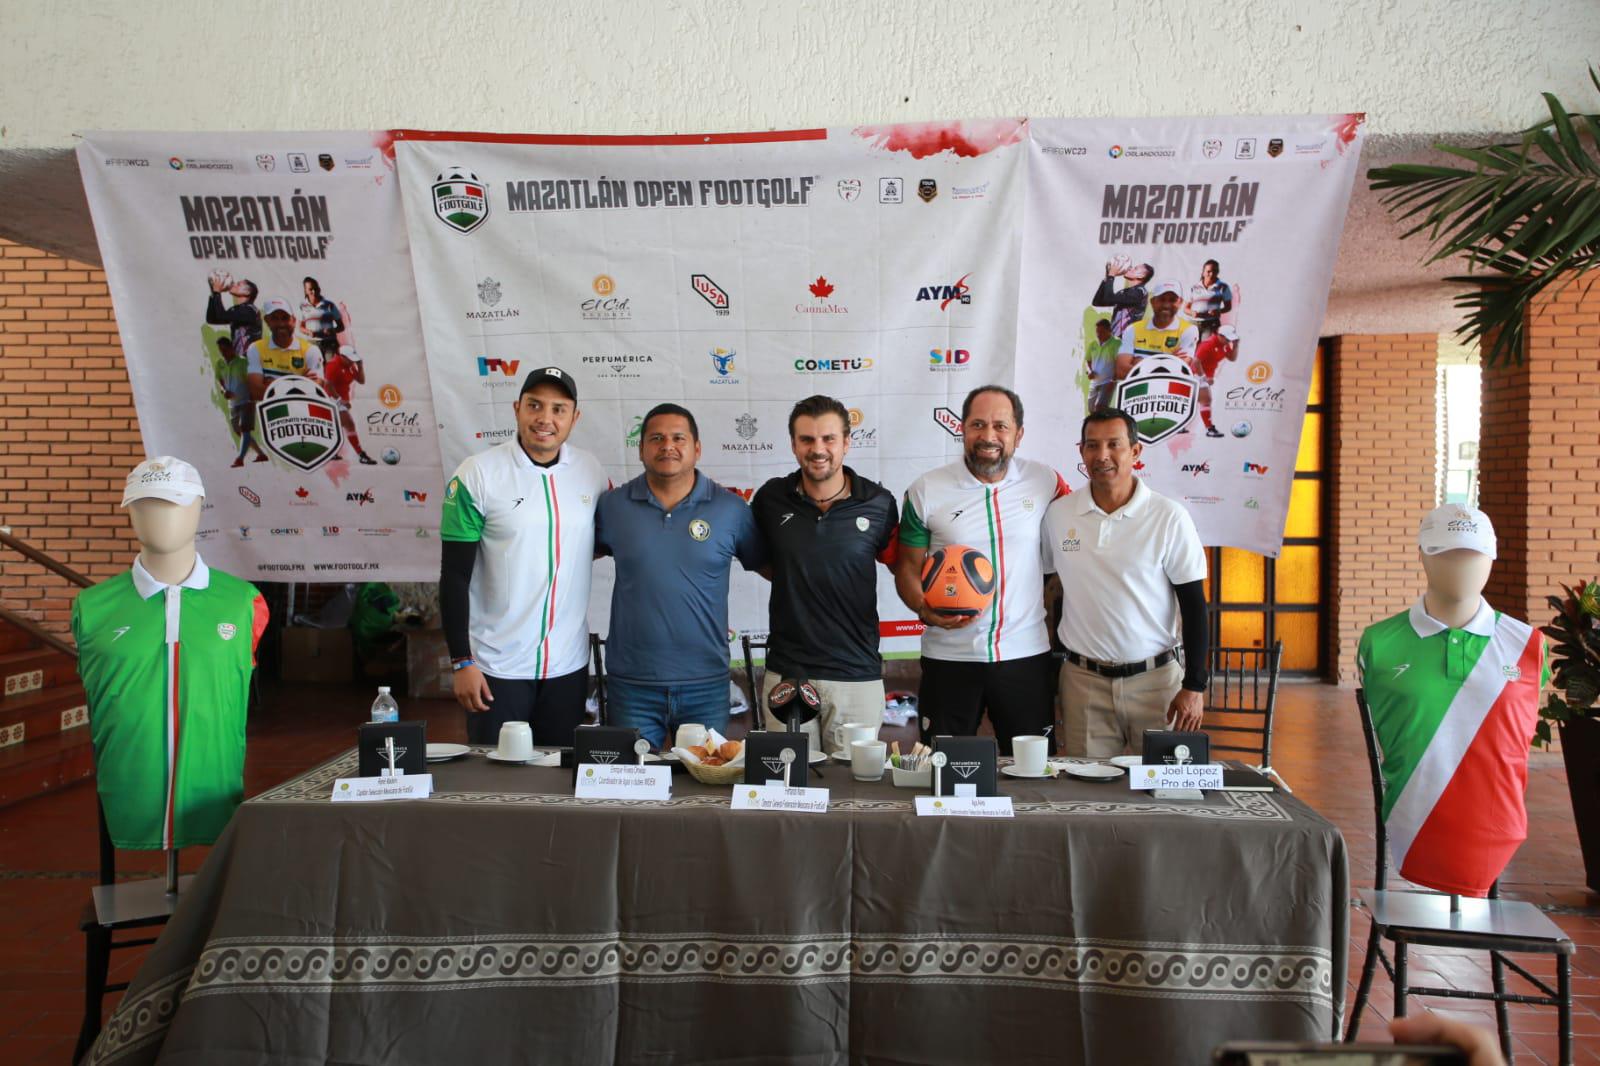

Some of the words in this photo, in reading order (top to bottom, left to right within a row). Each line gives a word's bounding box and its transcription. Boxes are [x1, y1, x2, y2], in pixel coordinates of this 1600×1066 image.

[506, 176, 628, 211] MAZATLÁN
[633, 180, 693, 207] OPEN
[699, 176, 814, 208] FOOTGOLF
[1102, 176, 1259, 219] MAZATLÁN
[180, 188, 331, 232] MAZATLÁN
[439, 199, 484, 212] FOOTGOLF
[1100, 221, 1146, 245] OPEN
[1152, 220, 1246, 246] FOOTGOLF
[190, 235, 238, 259] OPEN
[241, 235, 329, 262] FOOTGOLF
[696, 278, 725, 305] IUSA
[915, 286, 961, 301] AYM
[581, 299, 602, 311] El
[795, 303, 848, 314] CannaMex
[466, 308, 519, 319] MAZATLÁN
[582, 355, 653, 363] PERFUMÉRICA
[930, 349, 970, 364] SID
[1226, 386, 1249, 400] El
[1126, 400, 1189, 416] FOOTGOLF
[367, 411, 388, 425] El
[270, 424, 334, 441] FOOTGOLF
[722, 442, 773, 450] MAZATLÁN
[313, 562, 380, 570] WWW.FOOTGOLF.MX
[1162, 766, 1184, 775] Joel
[1161, 779, 1179, 788] Pro
[1182, 779, 1195, 788] de
[1198, 779, 1220, 788] Golf
